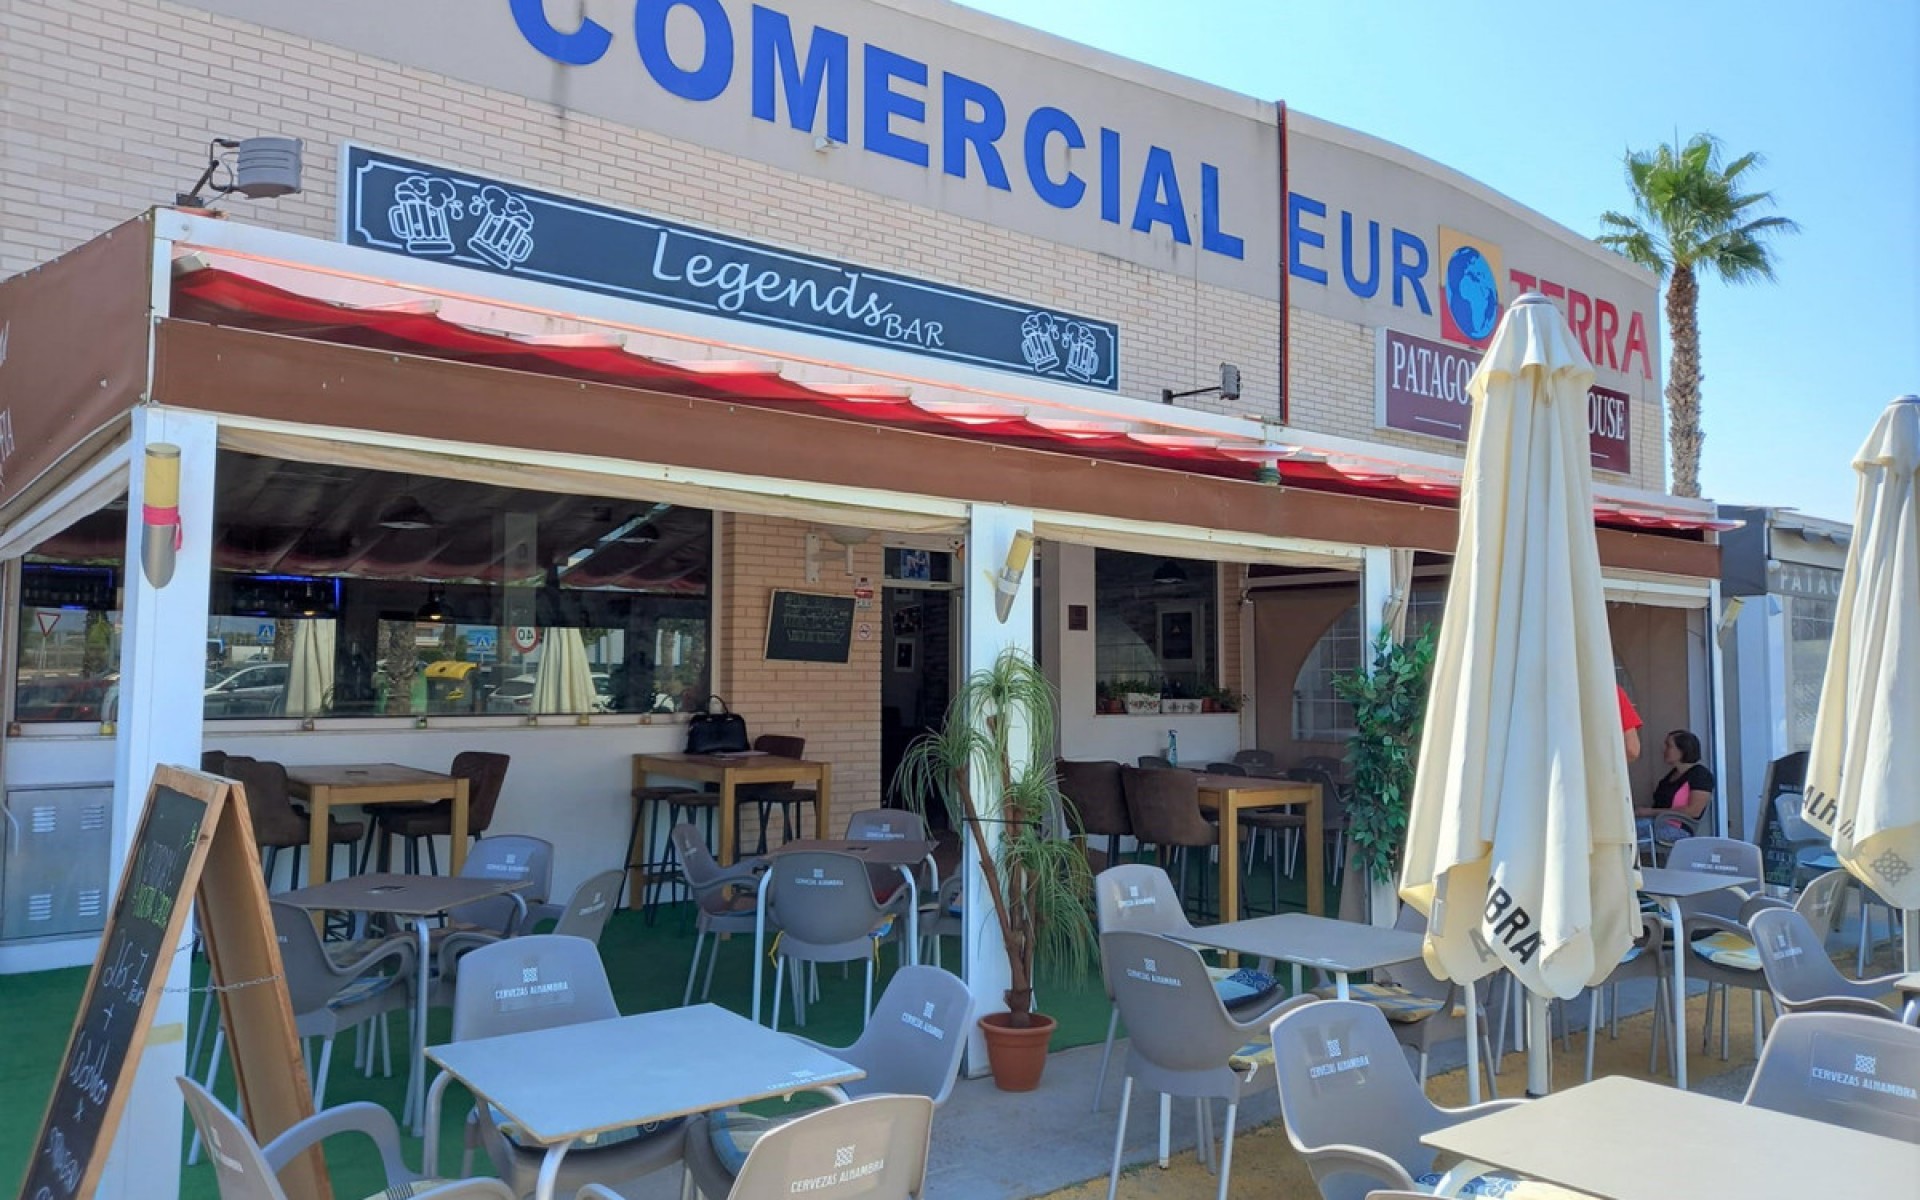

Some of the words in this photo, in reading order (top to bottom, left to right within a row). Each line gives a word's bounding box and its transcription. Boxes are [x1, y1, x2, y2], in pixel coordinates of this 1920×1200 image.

[509, 0, 1245, 261] COMERCIAL
[1288, 191, 1433, 317] EUR
[1509, 268, 1653, 381] TRRA
[652, 231, 894, 327] Legends
[883, 313, 945, 348] BAR
[1391, 340, 1476, 406] PATAGO
[1812, 1067, 1860, 1087] CERVEZAS
[790, 1173, 838, 1193] CERVEZAS
